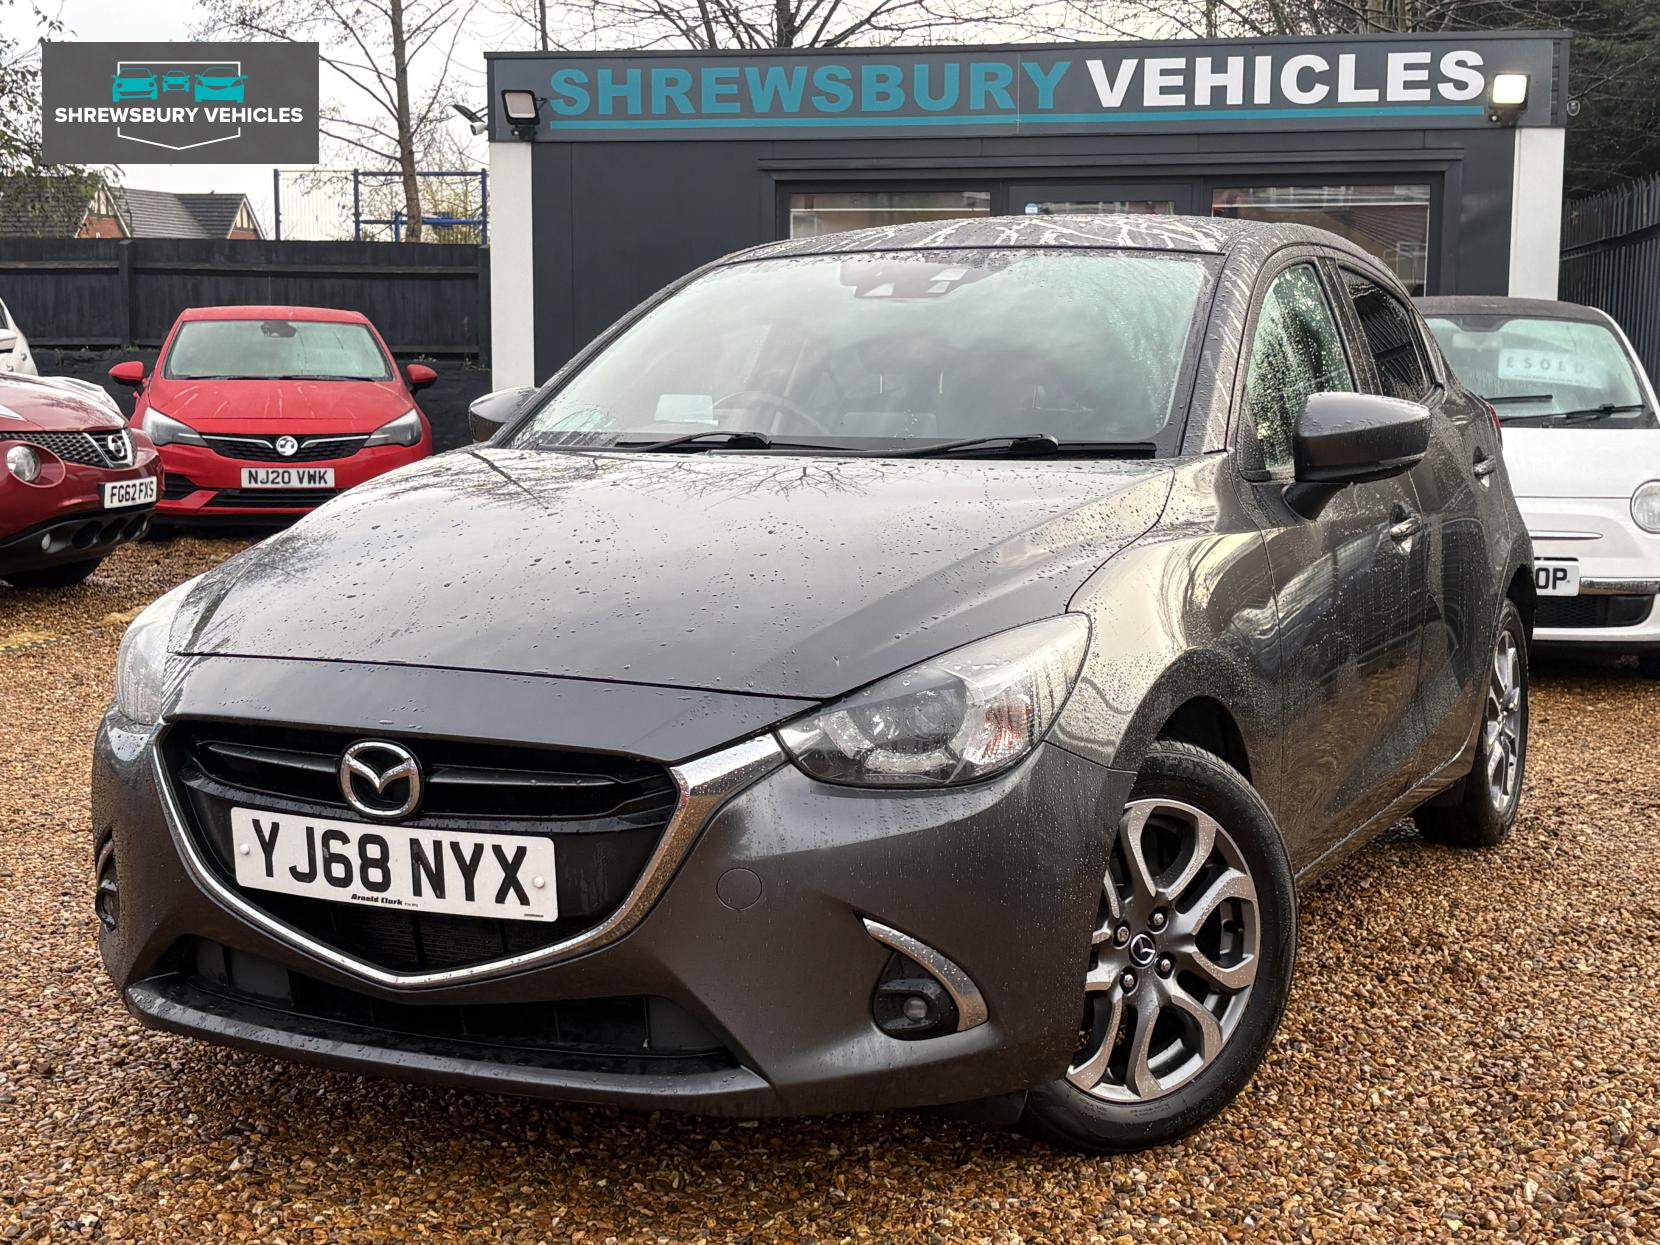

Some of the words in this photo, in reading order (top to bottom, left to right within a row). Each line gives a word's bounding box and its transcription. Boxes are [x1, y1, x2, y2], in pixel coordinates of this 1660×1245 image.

[549, 60, 1073, 116] SHREWSBURY
[1086, 49, 1487, 109] VEHICLES
[248, 469, 291, 486] NJ20
[296, 469, 328, 485] VWK
[110, 482, 137, 504] FG62
[138, 481, 154, 500] FXS
[251, 818, 392, 893] YJ68
[409, 837, 531, 907] NYX
[351, 893, 379, 903] Arnold
[380, 896, 403, 906] Clark
